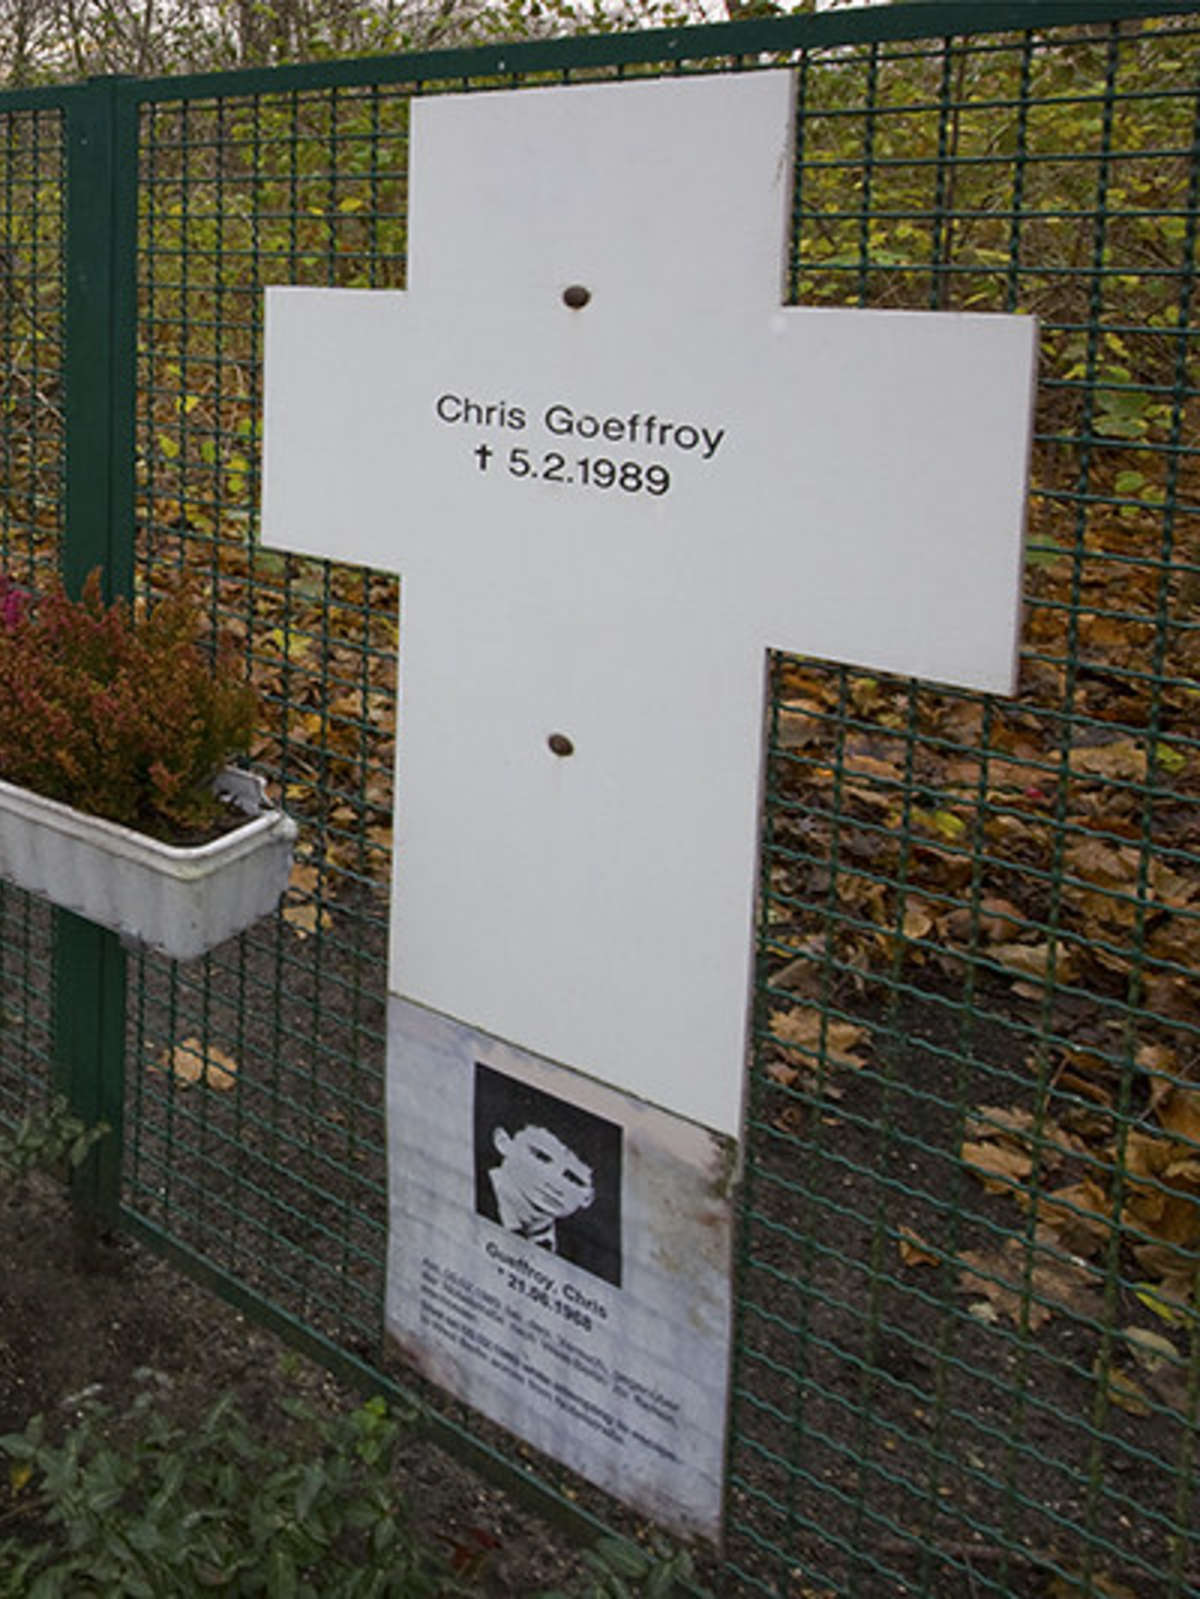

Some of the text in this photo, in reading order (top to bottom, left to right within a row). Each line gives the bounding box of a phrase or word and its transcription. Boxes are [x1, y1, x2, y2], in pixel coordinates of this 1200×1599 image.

[436, 394, 725, 459] Chris Goeffroy
[508, 448, 671, 496] 5.2.1989
